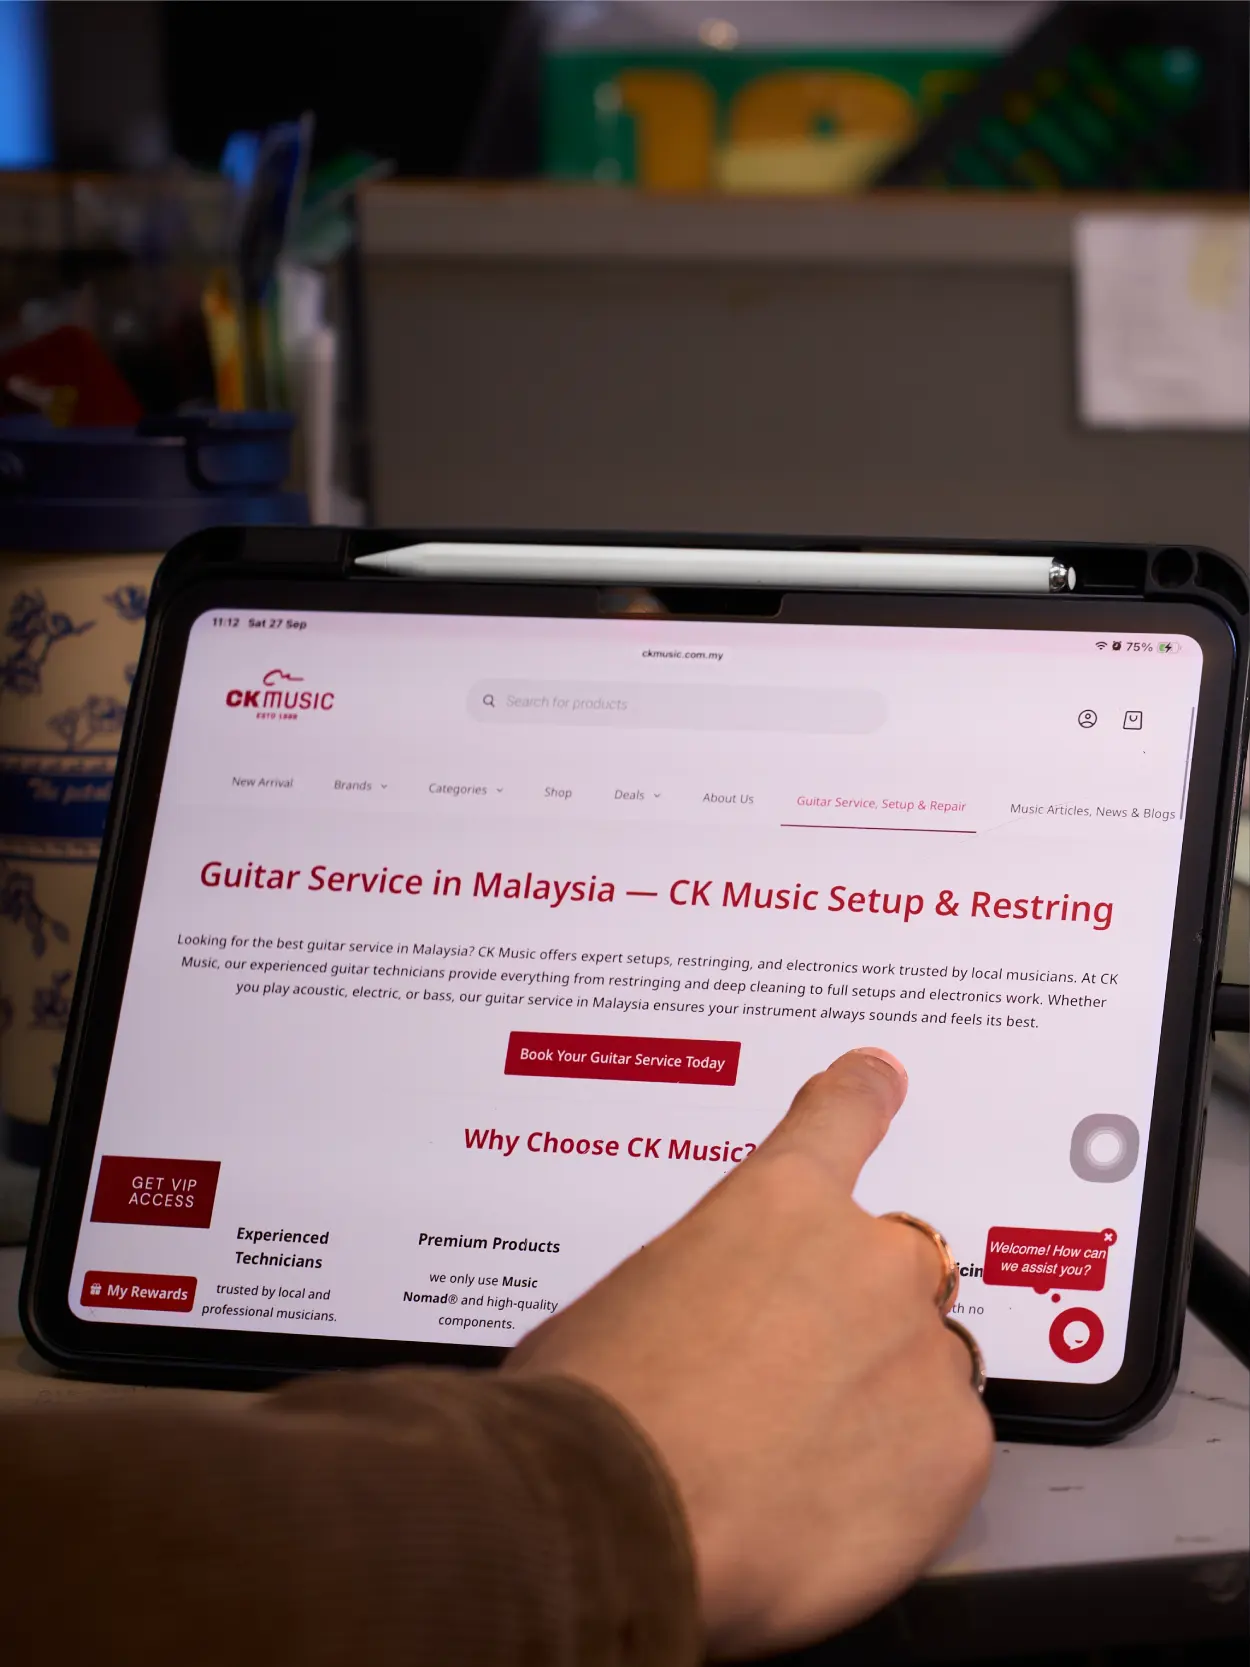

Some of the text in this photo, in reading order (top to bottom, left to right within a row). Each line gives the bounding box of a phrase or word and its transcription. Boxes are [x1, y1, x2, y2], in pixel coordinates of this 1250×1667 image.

[213, 617, 307, 631] 11:12 Sat 27 Sep
[641, 648, 724, 662] ckmusic.com.my
[1125, 641, 1154, 653] 75%
[225, 688, 335, 711] CK MUSIC
[505, 694, 629, 712] Search for products
[231, 776, 294, 789] New Arrival
[333, 779, 372, 792] Brands
[428, 782, 488, 798] Categories
[543, 786, 573, 801] Shop
[614, 788, 645, 801] Deals
[702, 792, 755, 805] About Us
[796, 795, 967, 814] Guitar Service, Setup & Repair
[1010, 803, 1177, 824] Music Articles, News & Blogs
[200, 860, 301, 890] Guitar
[307, 864, 423, 895] Service
[432, 869, 462, 897] in
[472, 872, 615, 909] Malaysia
[669, 879, 713, 907] CK
[722, 881, 819, 911] Music
[827, 885, 924, 923] Setup
[934, 889, 960, 917] &
[970, 891, 1114, 931] Restring
[177, 933, 1119, 986] Looking for the best guitar service in Malaysia? CK Music offers expert setups, restringing, and electronics work trusted by local musicians. At CK
[181, 956, 1108, 1008] Music, our experienced guitar technicians provide everything from restringing and deep cleaning to full setups and electronics work. Whether
[235, 982, 1039, 1029] you play acoustic, electric, or bass, our guitar service in Malaysia ensures your instrument always sounds and feels its best.
[520, 1047, 726, 1073] Book Your Guitar Service Today
[464, 1128, 521, 1157] Why
[526, 1131, 620, 1157] Choose
[627, 1136, 663, 1159] CK
[131, 1175, 198, 1192] GET VIP
[128, 1192, 195, 1209] ACCESS
[236, 1226, 330, 1245] Experienced
[418, 1232, 561, 1254] Premium Products
[989, 1240, 1107, 1259] Welcome! How can
[235, 1251, 323, 1269] Technicians
[1000, 1261, 1092, 1278] we assist you?
[429, 1273, 538, 1289] we only use Music
[107, 1283, 189, 1301] My Rewards
[216, 1284, 331, 1301] trusted by local and
[201, 1303, 337, 1322] professional musicians.
[460, 1295, 484, 1307] and
[486, 1296, 558, 1313] high-quality
[968, 1305, 985, 1315] no
[438, 1316, 515, 1330] components.
